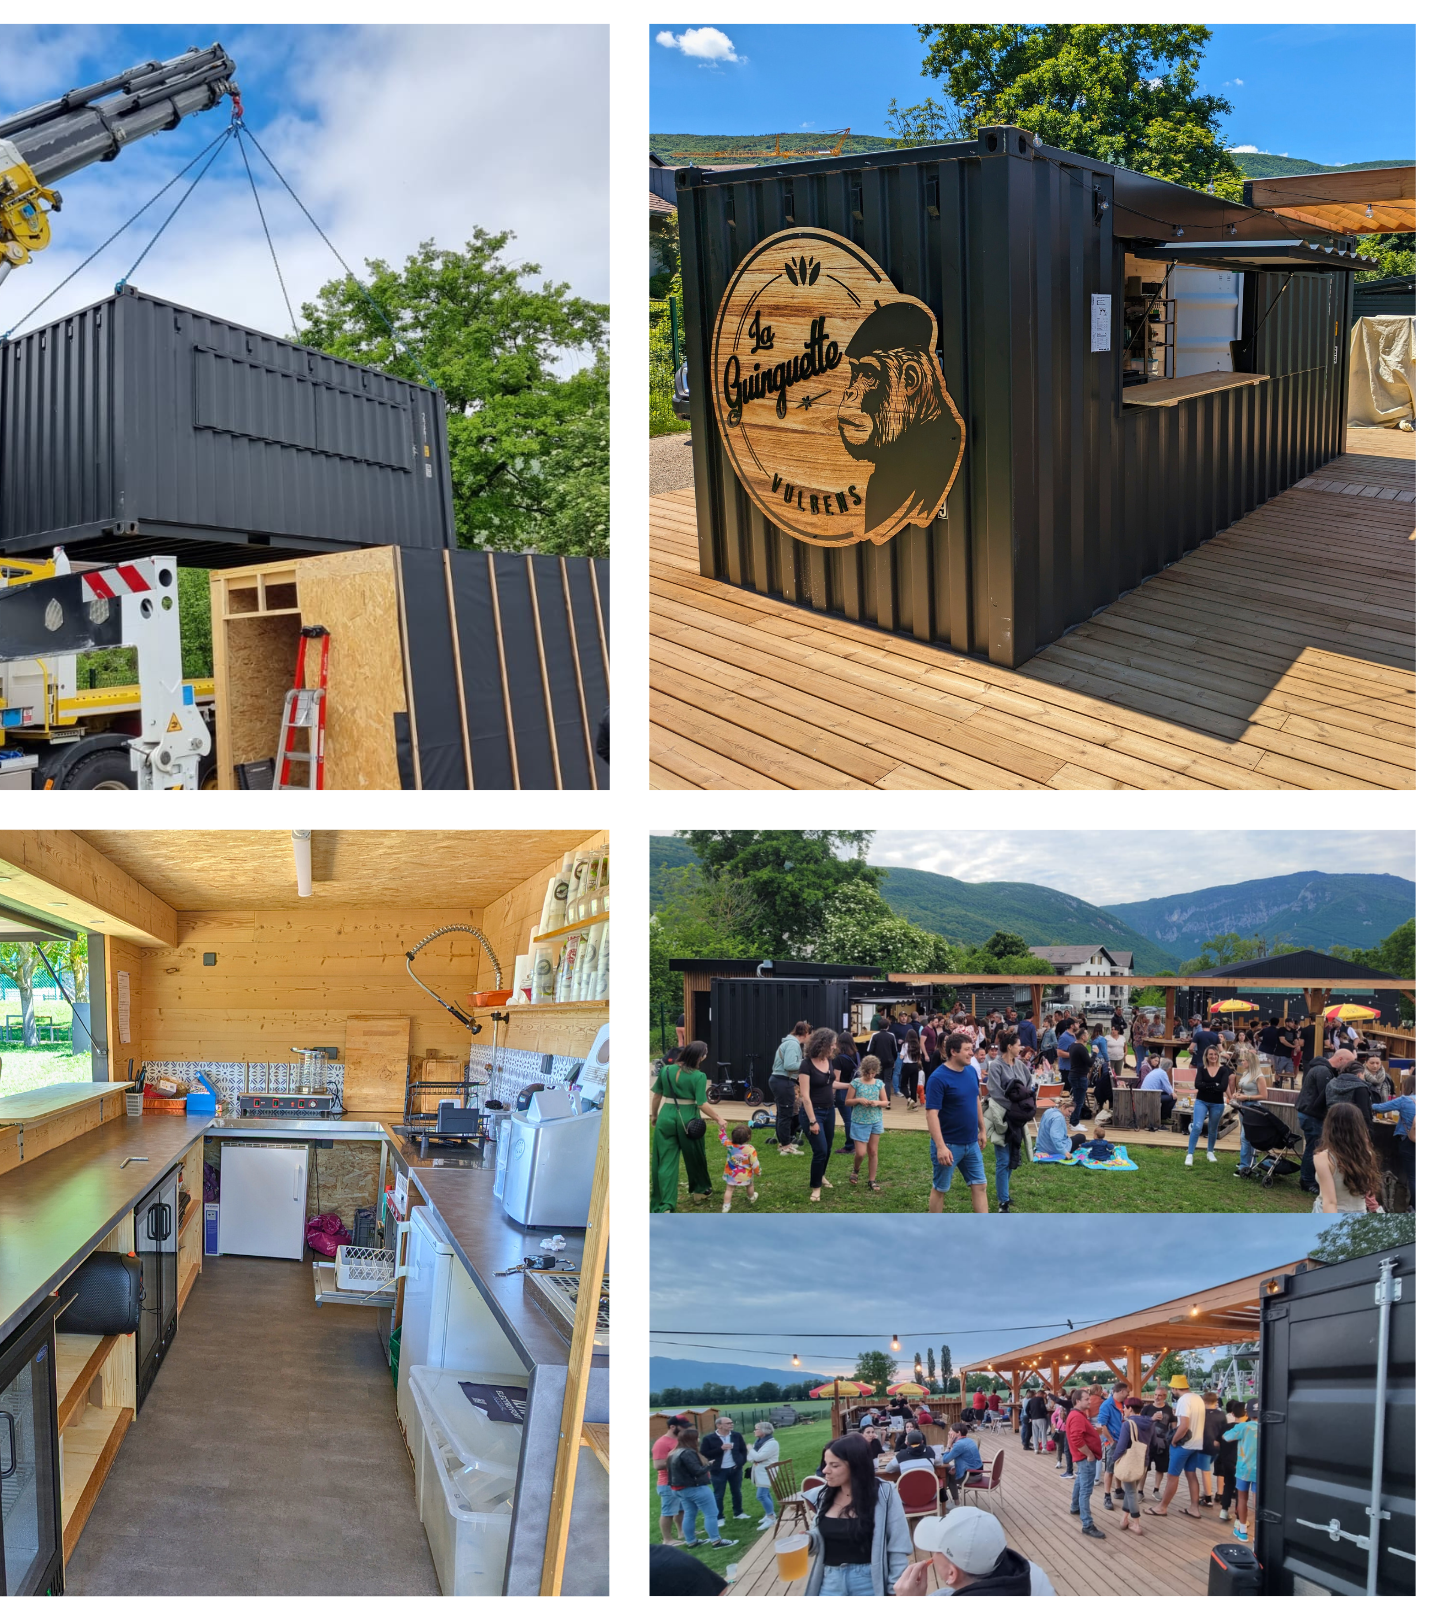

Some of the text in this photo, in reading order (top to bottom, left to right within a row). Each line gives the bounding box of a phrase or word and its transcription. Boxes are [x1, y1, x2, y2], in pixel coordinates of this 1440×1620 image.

[748, 310, 776, 354] La
[723, 316, 843, 428] Guinguette
[771, 472, 862, 516] VULBENS
